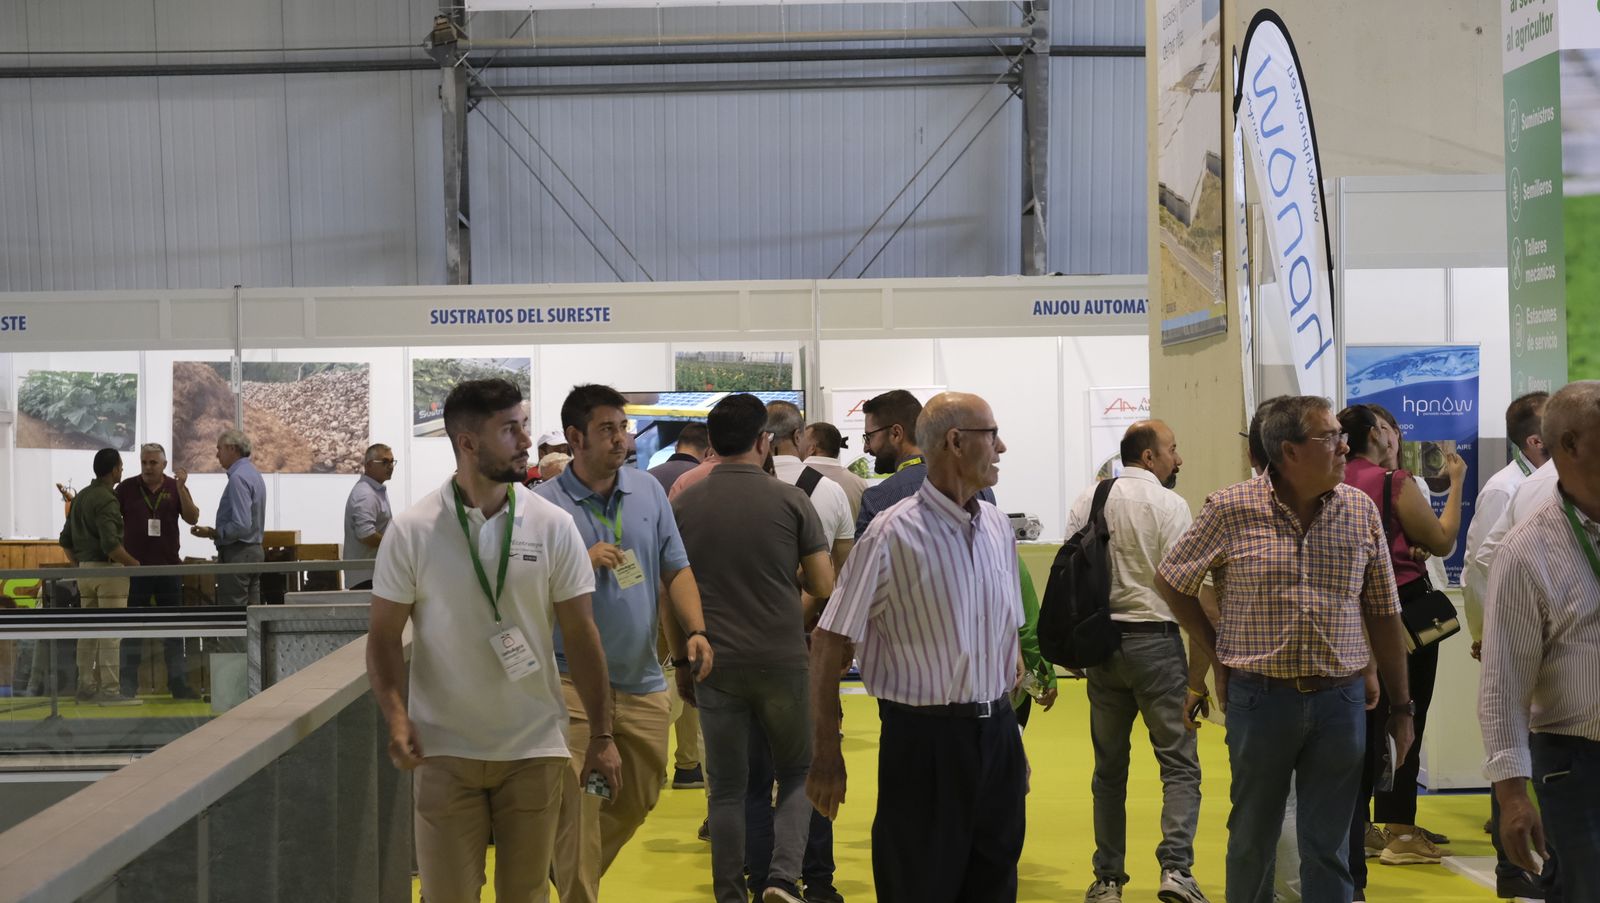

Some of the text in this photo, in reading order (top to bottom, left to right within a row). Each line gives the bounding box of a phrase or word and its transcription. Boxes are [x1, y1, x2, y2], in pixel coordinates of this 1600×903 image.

[1506, 12, 1553, 52] al agricultor
[1521, 107, 1554, 131] Suministros
[1523, 179, 1552, 200] Semilleros
[1525, 238, 1547, 256] Talleres
[430, 307, 610, 324] SUSTRATOS DEL SURESTE
[1033, 300, 1080, 315] ANJOU
[1084, 299, 1149, 315] AUTOMA
[1526, 307, 1557, 325] Estaciones
[1527, 332, 1558, 350] de servicio
[1403, 395, 1473, 416] hpnow
